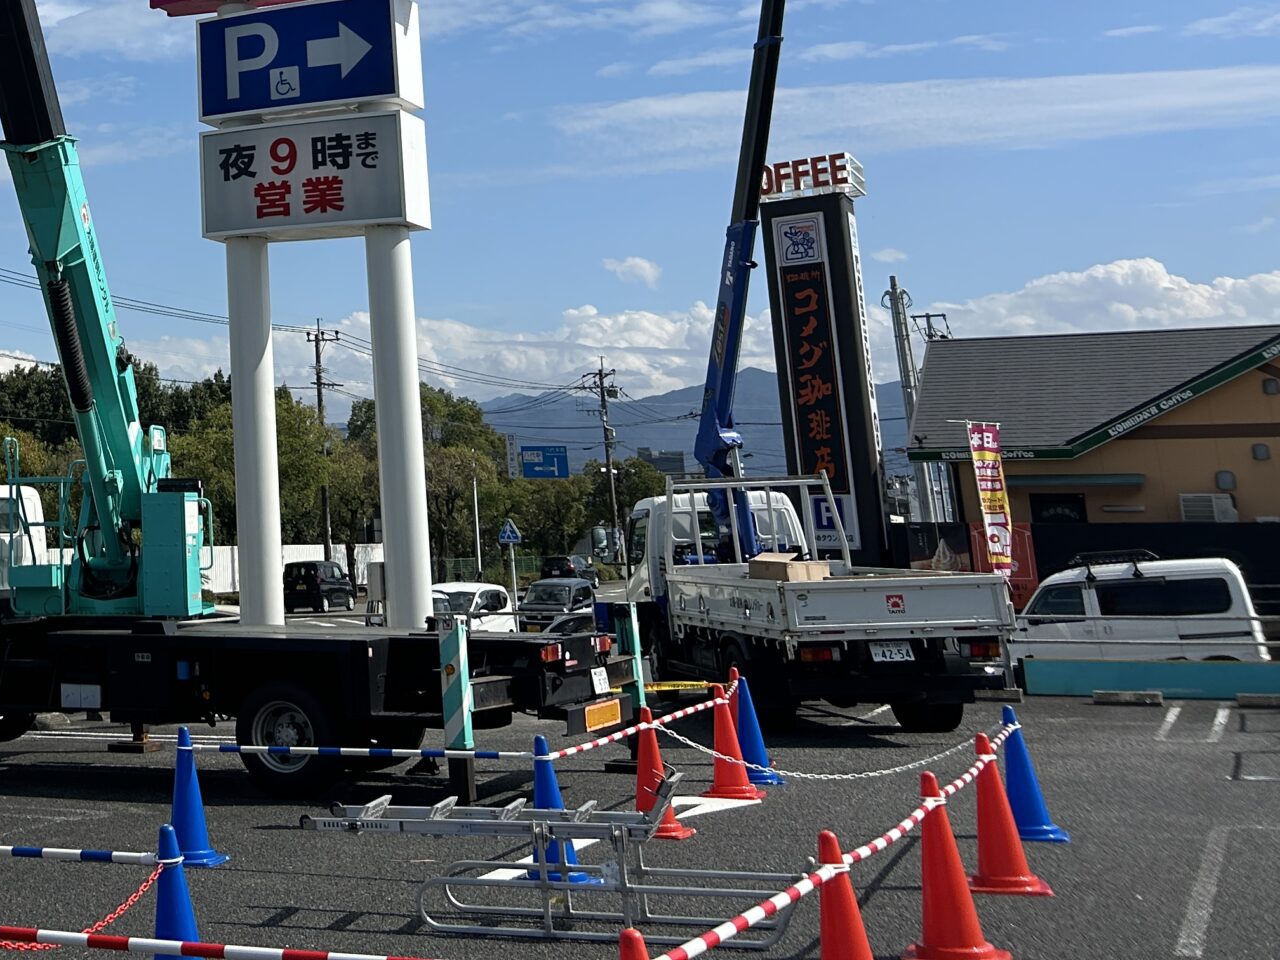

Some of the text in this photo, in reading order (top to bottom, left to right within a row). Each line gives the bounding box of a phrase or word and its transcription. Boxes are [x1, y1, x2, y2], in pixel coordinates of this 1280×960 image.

[224, 22, 279, 100] P
[762, 152, 848, 195] OFFEE
[254, 176, 345, 219] 営業
[795, 289, 836, 479] コメダ珈琲店
[1159, 390, 1193, 410] Coffee
